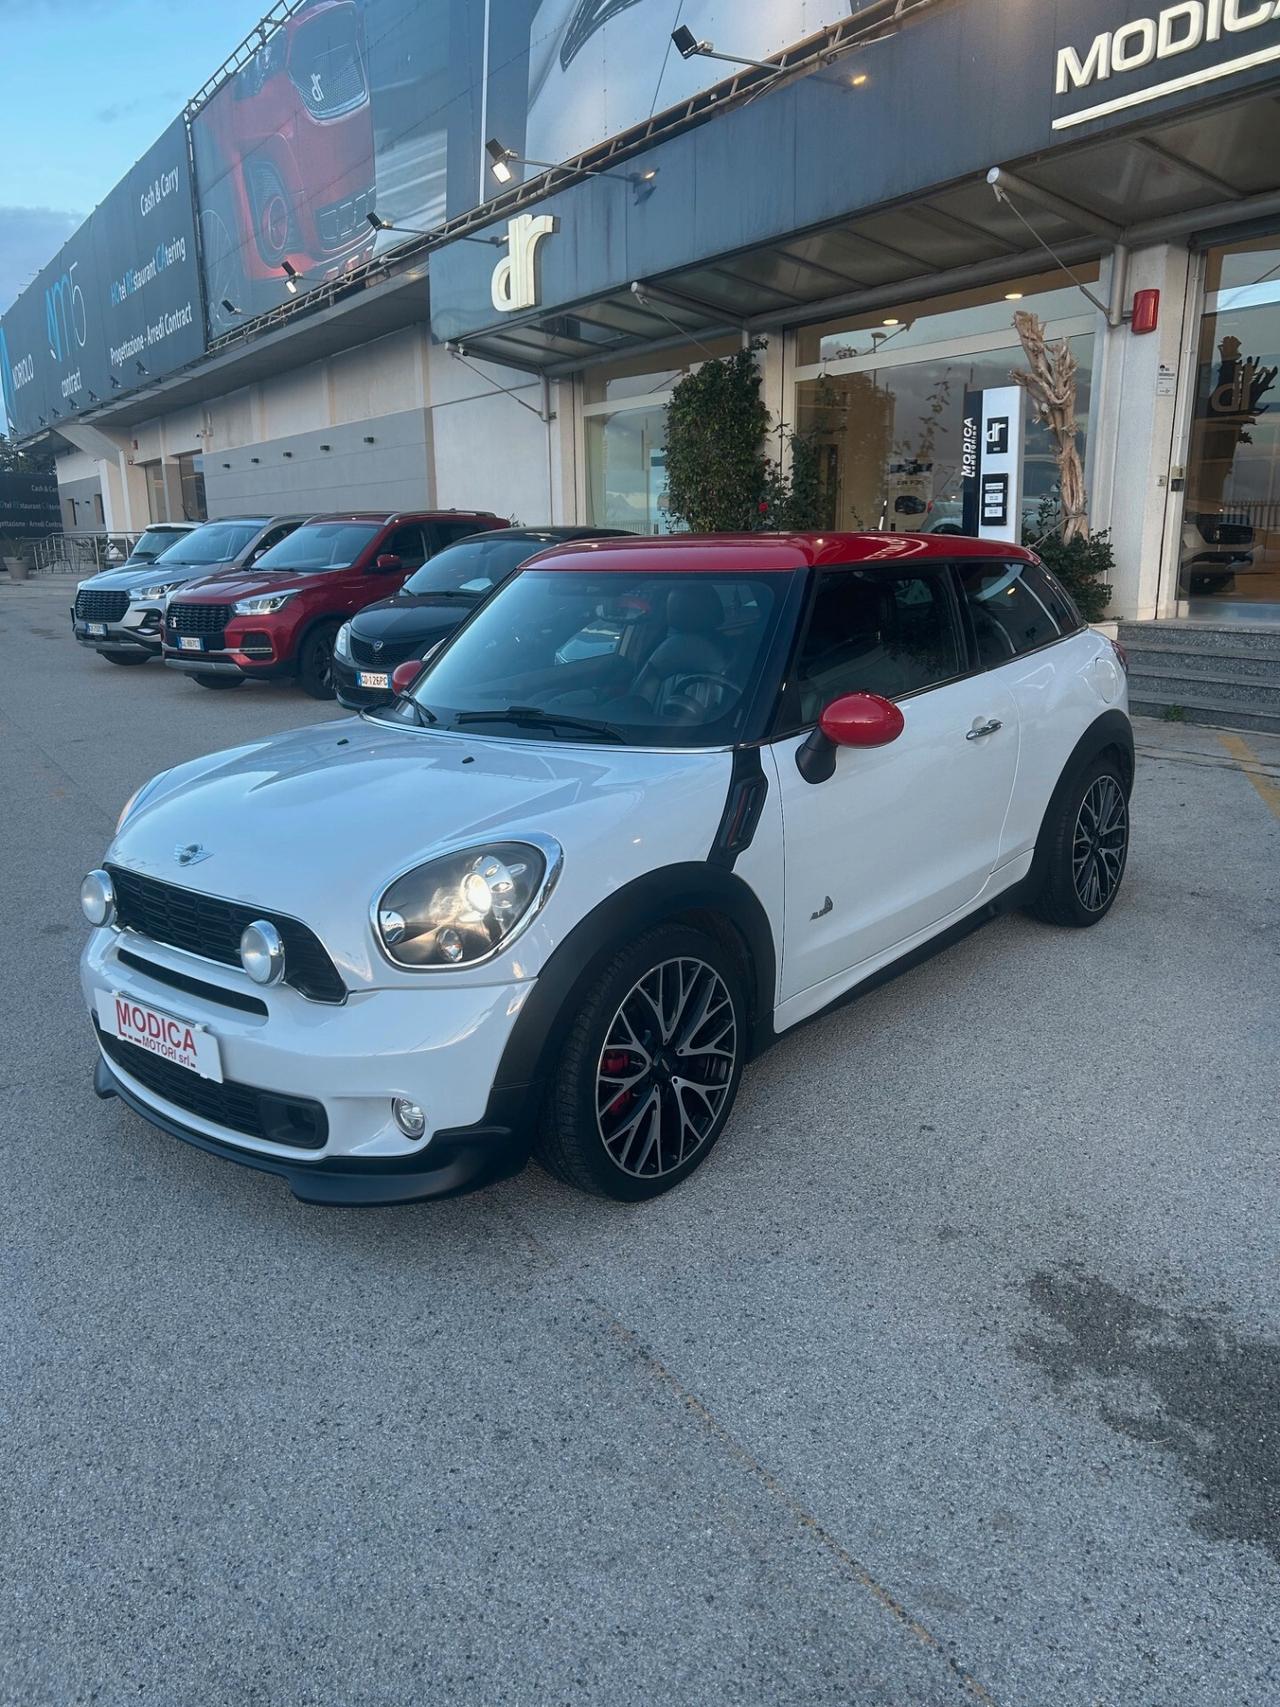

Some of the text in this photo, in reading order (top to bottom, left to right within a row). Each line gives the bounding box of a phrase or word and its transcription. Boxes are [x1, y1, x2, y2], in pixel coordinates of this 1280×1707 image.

[1056, 0, 1280, 94] MODIC
[140, 166, 180, 217] Cash & Carry
[155, 236, 187, 273] CAtering
[491, 213, 554, 312] dr
[110, 332, 144, 367] Progettazione
[147, 317, 164, 346] Arredi
[164, 302, 193, 337] Contract
[61, 367, 82, 398] contract
[961, 417, 973, 477] MODICA
[987, 422, 1006, 442] dr
[115, 999, 198, 1057] MODICA
[141, 1035, 190, 1067] MOTORI srl
